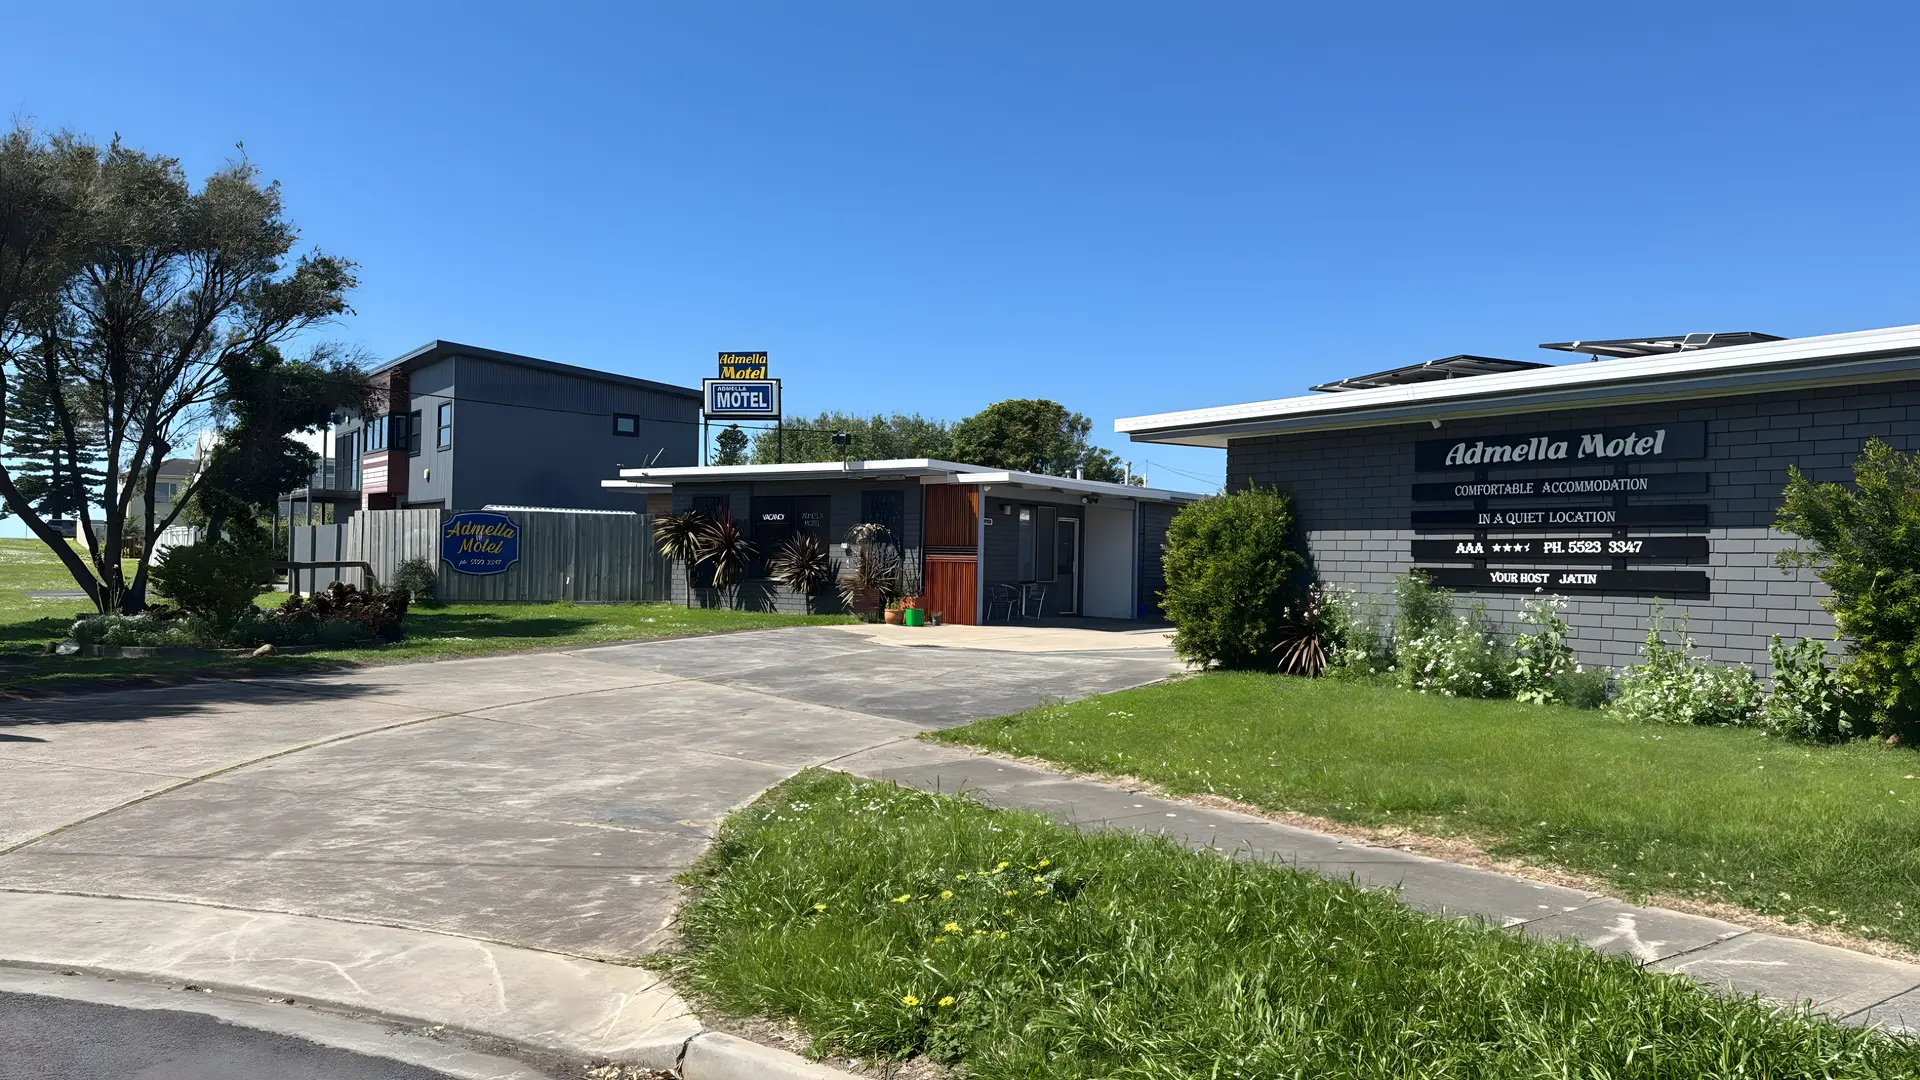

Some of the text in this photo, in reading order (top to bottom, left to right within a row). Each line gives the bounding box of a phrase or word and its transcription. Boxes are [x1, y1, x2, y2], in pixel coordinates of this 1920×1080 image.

[719, 353, 767, 364] Admella
[721, 366, 766, 379] Motel
[717, 392, 767, 407] MOTEL
[1445, 429, 1666, 466] Admella Motel
[1455, 478, 1648, 496] COMFORTABLE ACCOMMODATION
[1478, 511, 1616, 525] IN A QUIET LOCATION
[445, 520, 516, 538] Admella
[1455, 541, 1643, 554] AAA PH. 5523 3347
[1490, 571, 1597, 584] YOUR HOST JATIN
